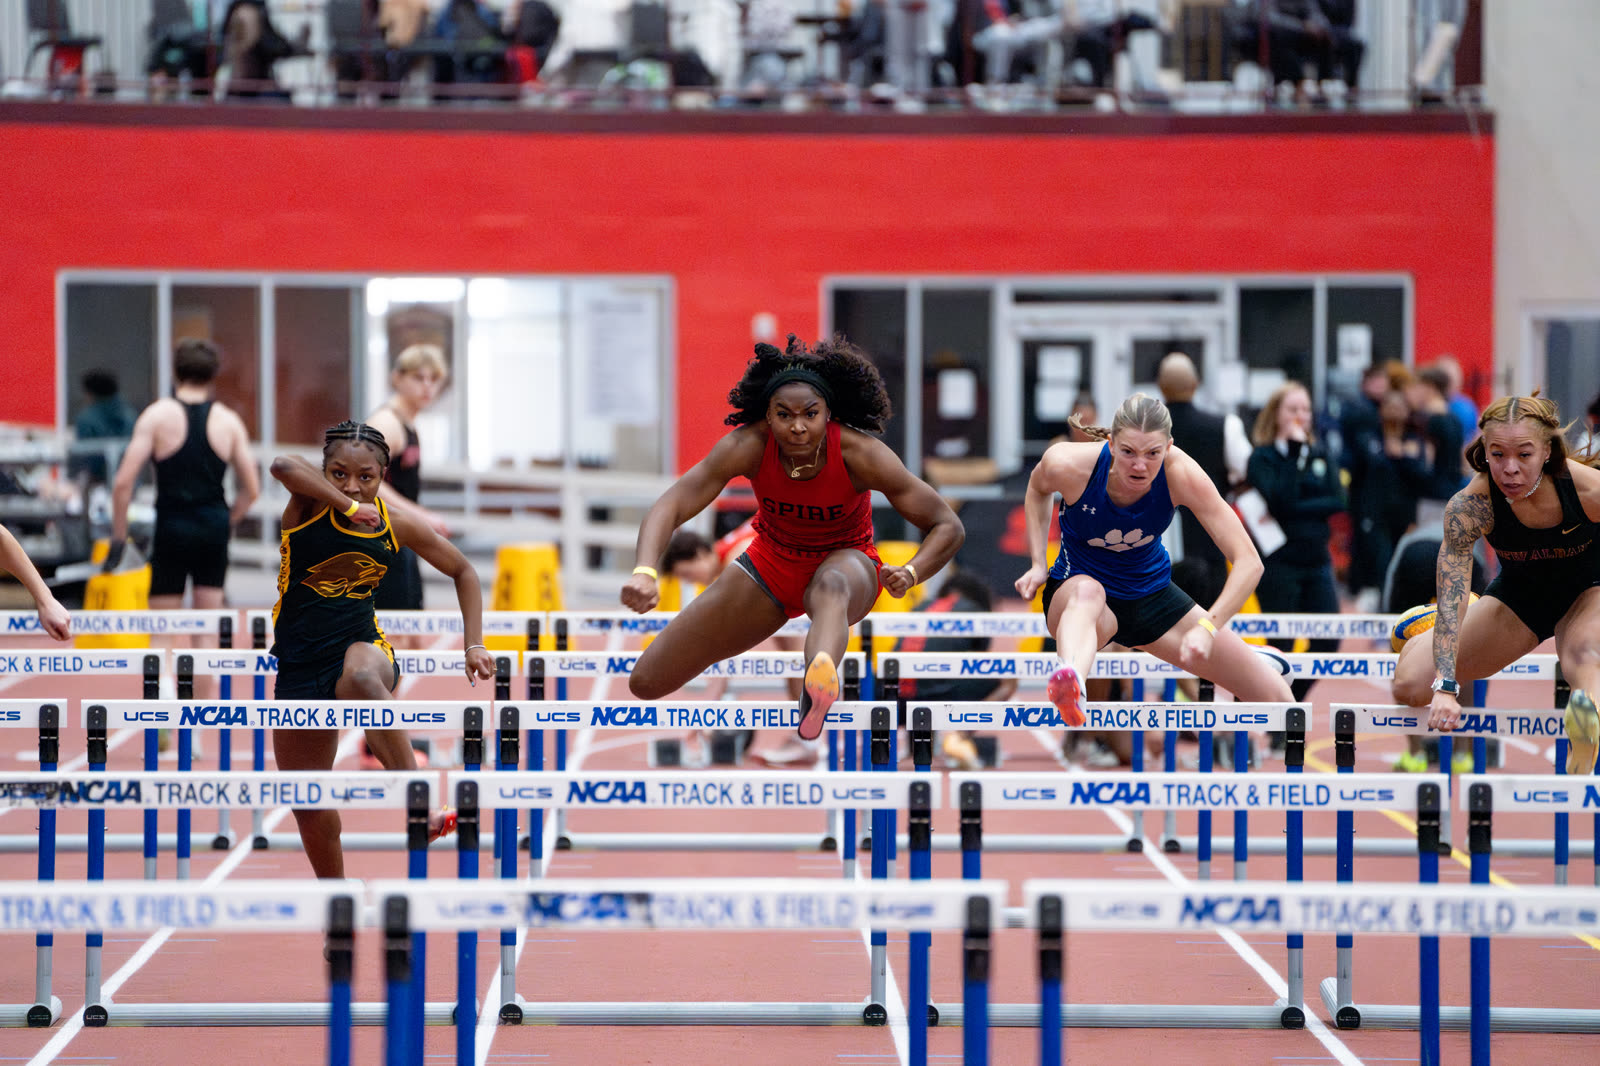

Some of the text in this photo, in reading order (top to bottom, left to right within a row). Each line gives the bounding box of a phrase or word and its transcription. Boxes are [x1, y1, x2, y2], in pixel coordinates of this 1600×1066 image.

[762, 497, 846, 521] SPIRE
[8, 616, 44, 632] NCA
[72, 617, 114, 633] RACK
[129, 617, 168, 633] FIELD
[439, 617, 465, 633] FIEL
[926, 619, 975, 634] NCAA
[1231, 620, 1280, 634] NCAA
[1288, 621, 1332, 635] TRACK
[23, 657, 33, 673] &
[39, 657, 83, 673] FIELD
[90, 660, 128, 669] UCS
[208, 659, 247, 669] UCS
[442, 661, 465, 670] UC
[559, 656, 637, 674] UCS NC
[726, 660, 736, 675] &
[742, 659, 784, 675] FIELD
[913, 659, 1060, 676] UCS NCAA TRA
[1097, 660, 1140, 676] FIELD
[1311, 659, 1369, 675] NCAA
[124, 705, 446, 728] UCS NCAA TRACK & FIELD UCS
[536, 706, 854, 728] UCS NCAA TRACK & FIELD CS
[949, 712, 993, 724] UCS
[1147, 709, 1160, 729] &
[1165, 709, 1216, 729] FIELD
[1223, 713, 1269, 725] UCS
[1373, 716, 1418, 728] UCS
[59, 780, 142, 804] NCAA
[154, 783, 234, 805] TRACK
[238, 783, 252, 804] &
[260, 782, 322, 804] FIELD
[331, 787, 385, 800] UCS
[499, 780, 887, 805] UCS NCAA TRACK & FIELD UCS
[1003, 782, 1395, 806] UCS NCAA TRACK & FIELD UCS
[1513, 791, 1569, 803] UCS
[1, 896, 97, 925] TRACK
[135, 896, 216, 926] FIELD
[775, 895, 857, 926] FIELD
[1179, 897, 1283, 925] NCAA
[1301, 898, 1396, 930] TRACK
[1436, 899, 1516, 931] FIELD
